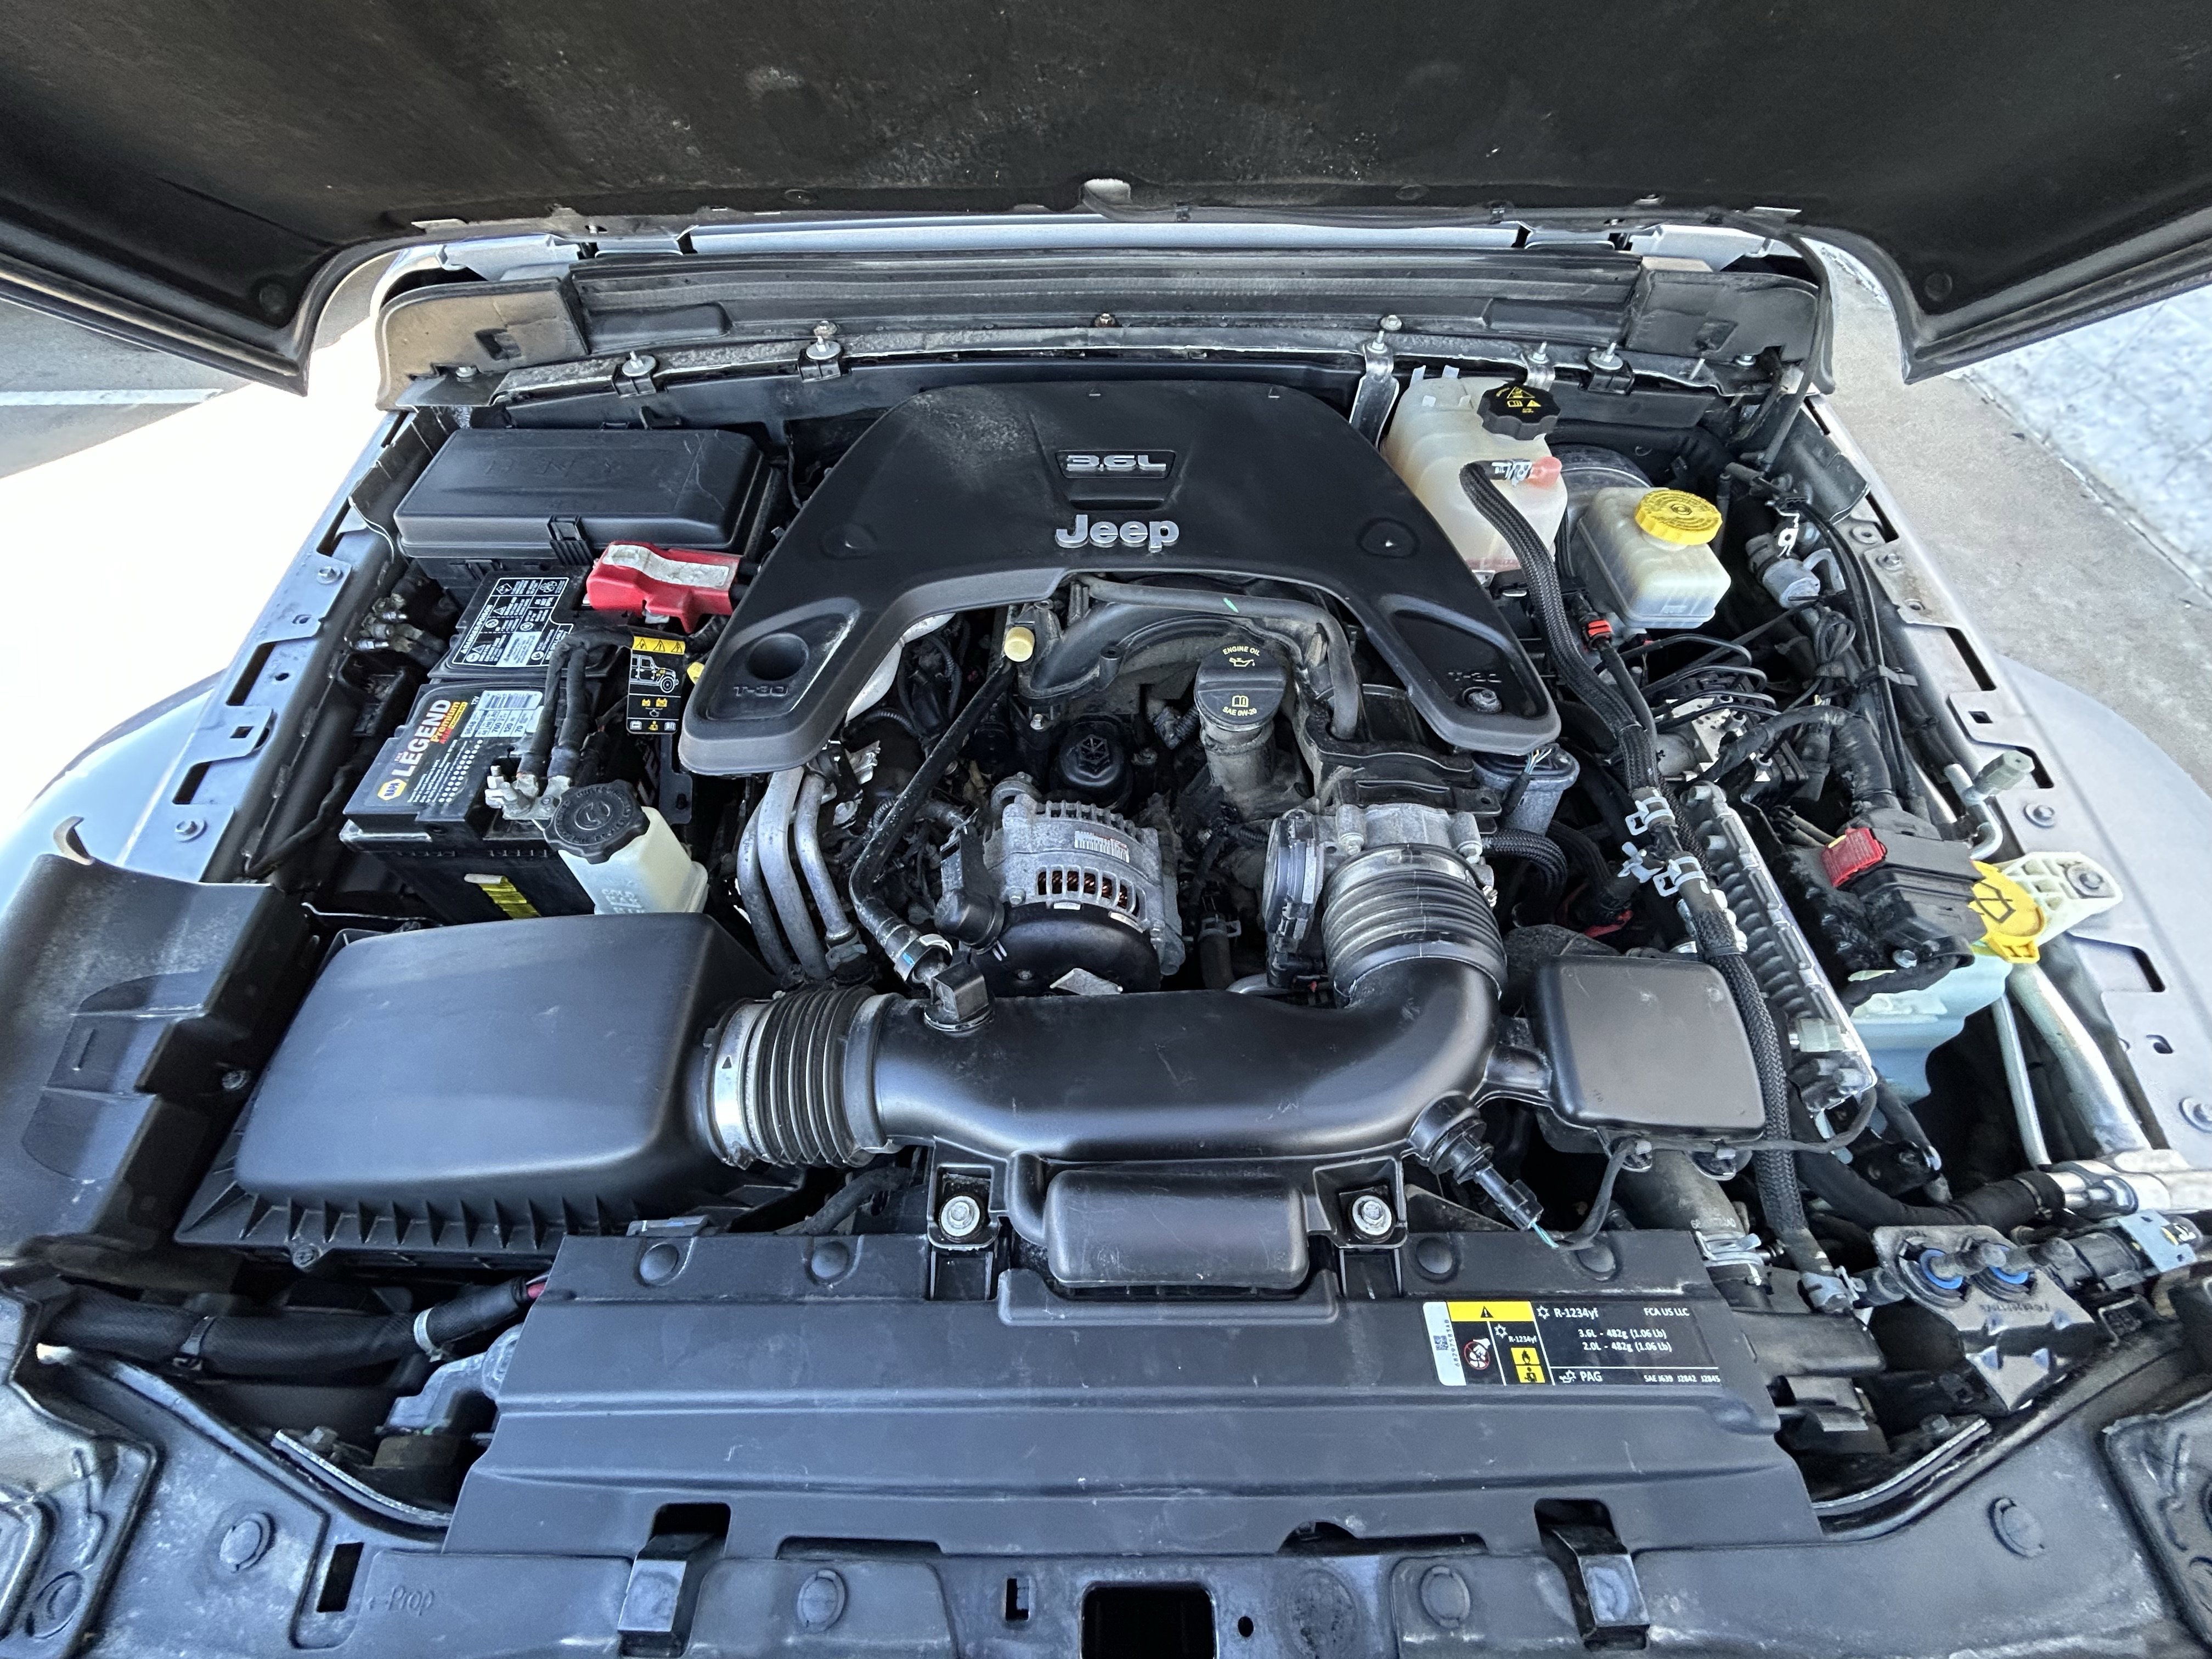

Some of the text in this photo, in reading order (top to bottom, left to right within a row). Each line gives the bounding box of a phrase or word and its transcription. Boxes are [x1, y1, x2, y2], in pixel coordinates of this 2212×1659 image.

[1066, 454, 1167, 472] 3.6L
[1055, 514, 1180, 553] Jeep
[1222, 645, 1261, 657] ENGINE OIL
[471, 696, 480, 706] 12V
[1222, 706, 1258, 716] SAE 0W-20
[430, 701, 461, 743] Premium
[391, 699, 452, 777] LEGEND
[384, 782, 400, 797] NAPA
[1553, 1307, 1599, 1320] R-1234yf
[1644, 1307, 1690, 1317] FCA US LLC
[1508, 1335, 1538, 1344] R-1234yf
[1577, 1329, 1598, 1339] 3.6L
[1606, 1329, 1629, 1340] 482g
[1629, 1329, 1653, 1339] (1.06
[1654, 1329, 1667, 1339] Lb)
[1582, 1342, 1602, 1351] 2.0L
[1611, 1342, 1634, 1353] 482g
[1634, 1342, 1657, 1352] (1.06
[1658, 1342, 1673, 1352] Lb)
[1580, 1371, 1603, 1383] PAG
[1644, 1375, 1658, 1383] SAE
[387, 1584, 436, 1617] Prop
